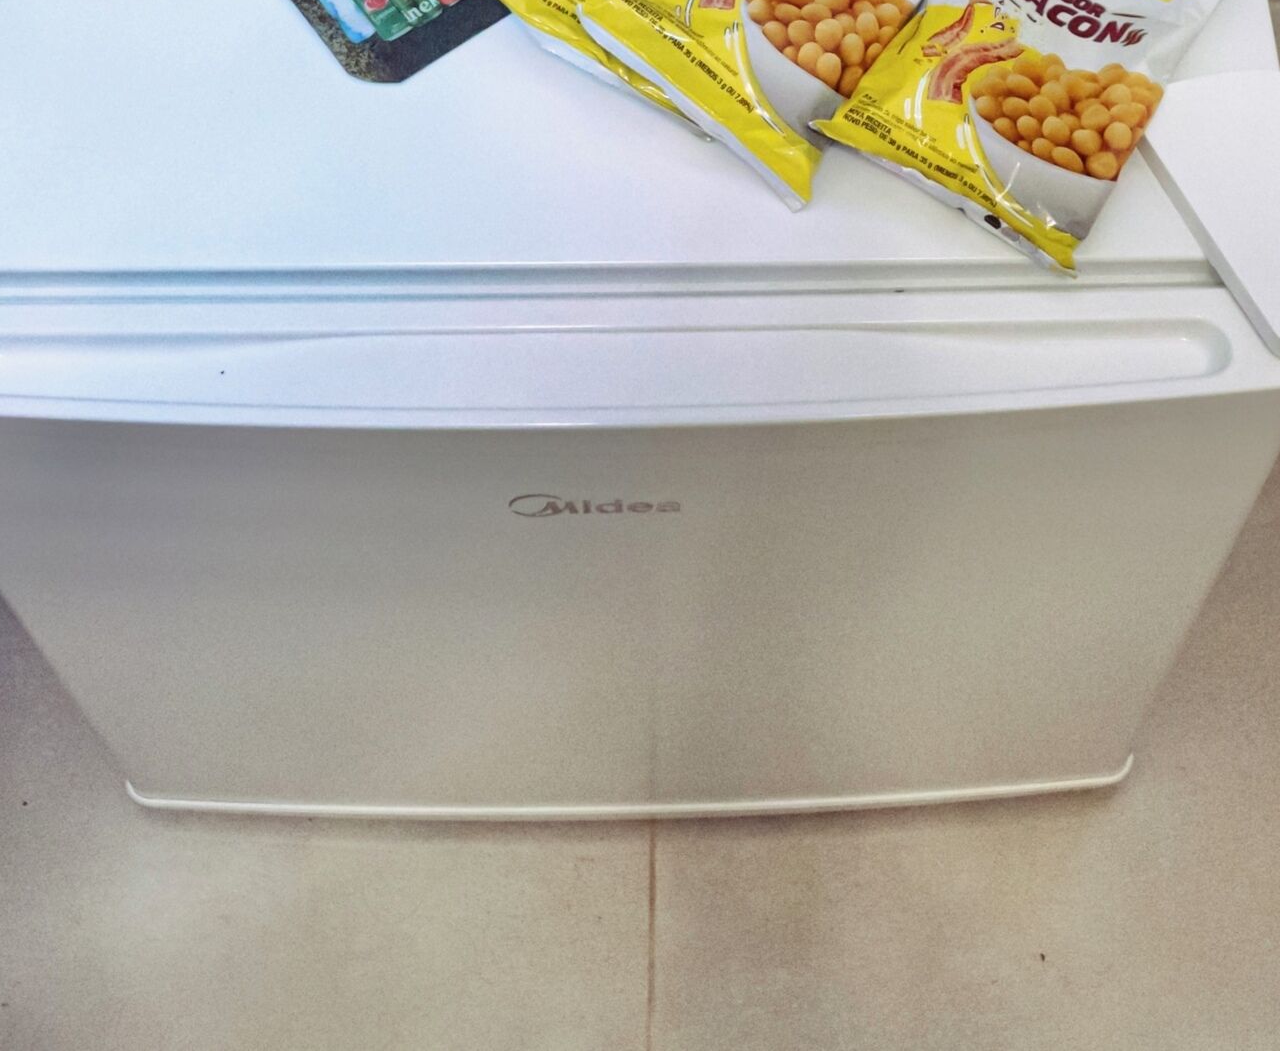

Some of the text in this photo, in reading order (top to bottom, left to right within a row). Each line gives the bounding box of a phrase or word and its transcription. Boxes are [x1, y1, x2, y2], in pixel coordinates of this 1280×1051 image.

[864, 114, 893, 135] RECEITA
[878, 131, 889, 141] DE
[900, 145, 919, 160] PARA
[520, 496, 681, 516] Midea
